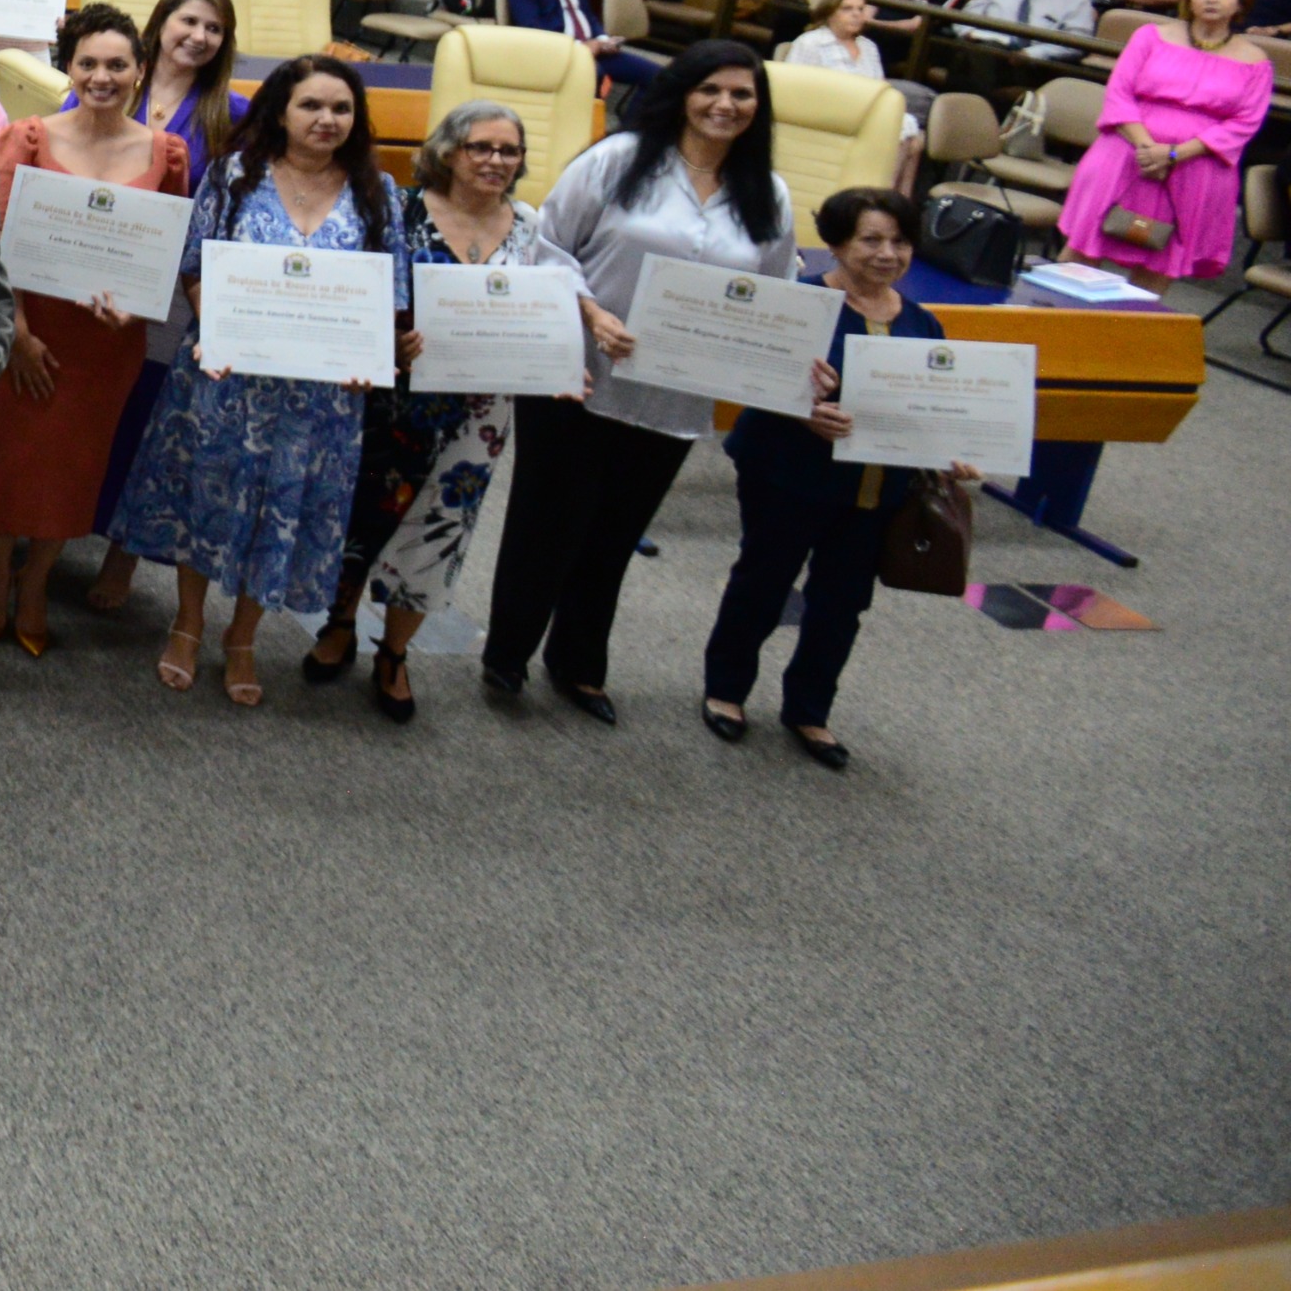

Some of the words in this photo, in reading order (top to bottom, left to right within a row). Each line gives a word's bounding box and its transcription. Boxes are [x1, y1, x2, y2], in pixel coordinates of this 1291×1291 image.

[32, 201, 71, 217] Diploma
[73, 210, 83, 219] de
[86, 212, 116, 226] Honra
[118, 220, 128, 228] ao
[227, 274, 267, 286] Diploma
[284, 279, 316, 290] Honra
